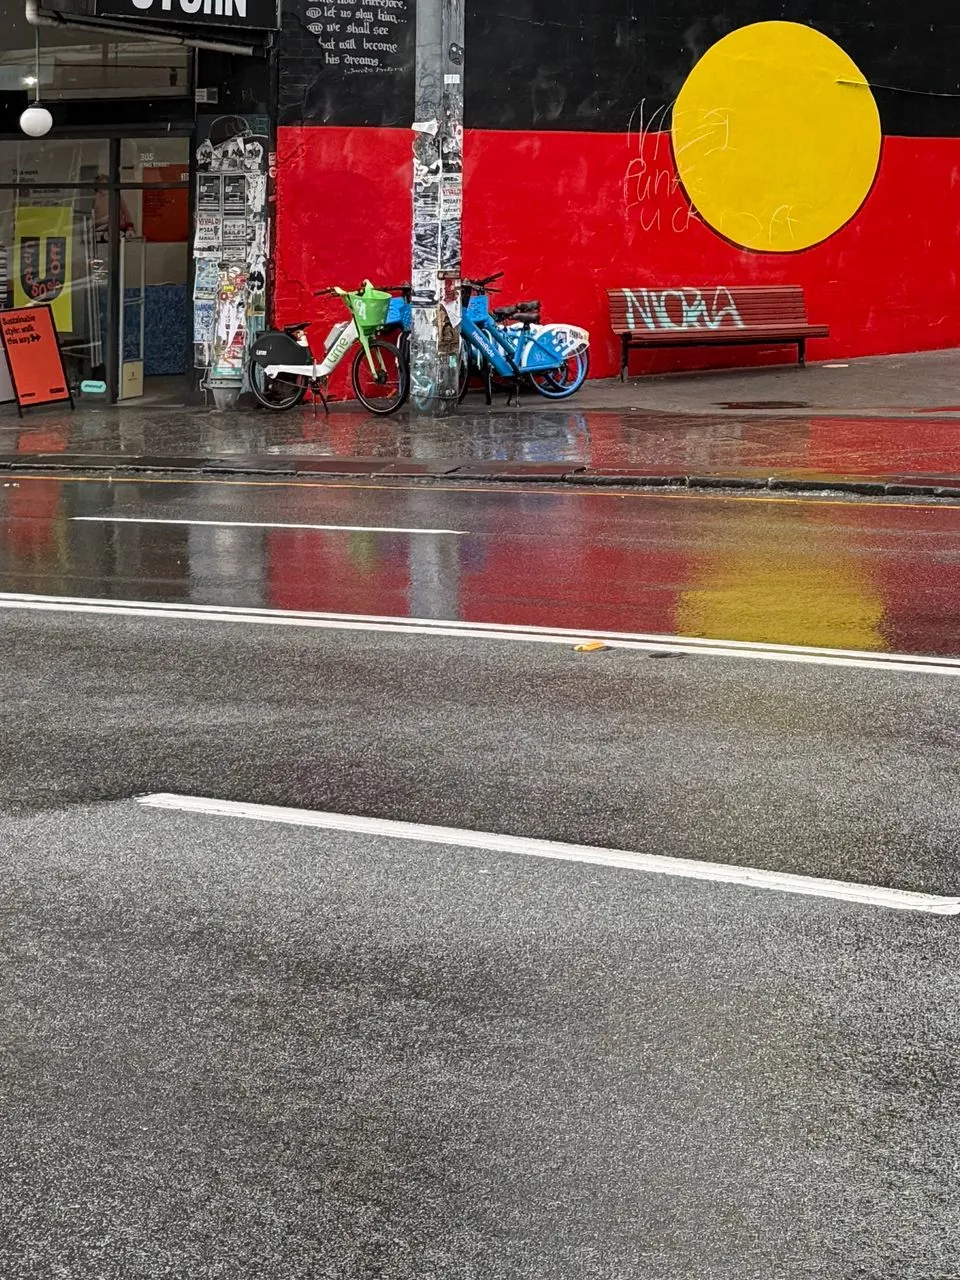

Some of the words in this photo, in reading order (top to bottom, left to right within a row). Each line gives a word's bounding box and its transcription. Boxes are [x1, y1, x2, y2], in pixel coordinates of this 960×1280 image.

[324, 6, 337, 17] let
[327, 24, 340, 32] we
[346, 22, 370, 34] shall
[373, 27, 389, 35] see
[339, 38, 356, 49] will
[325, 53, 340, 64] his
[327, 337, 349, 363] Lime
